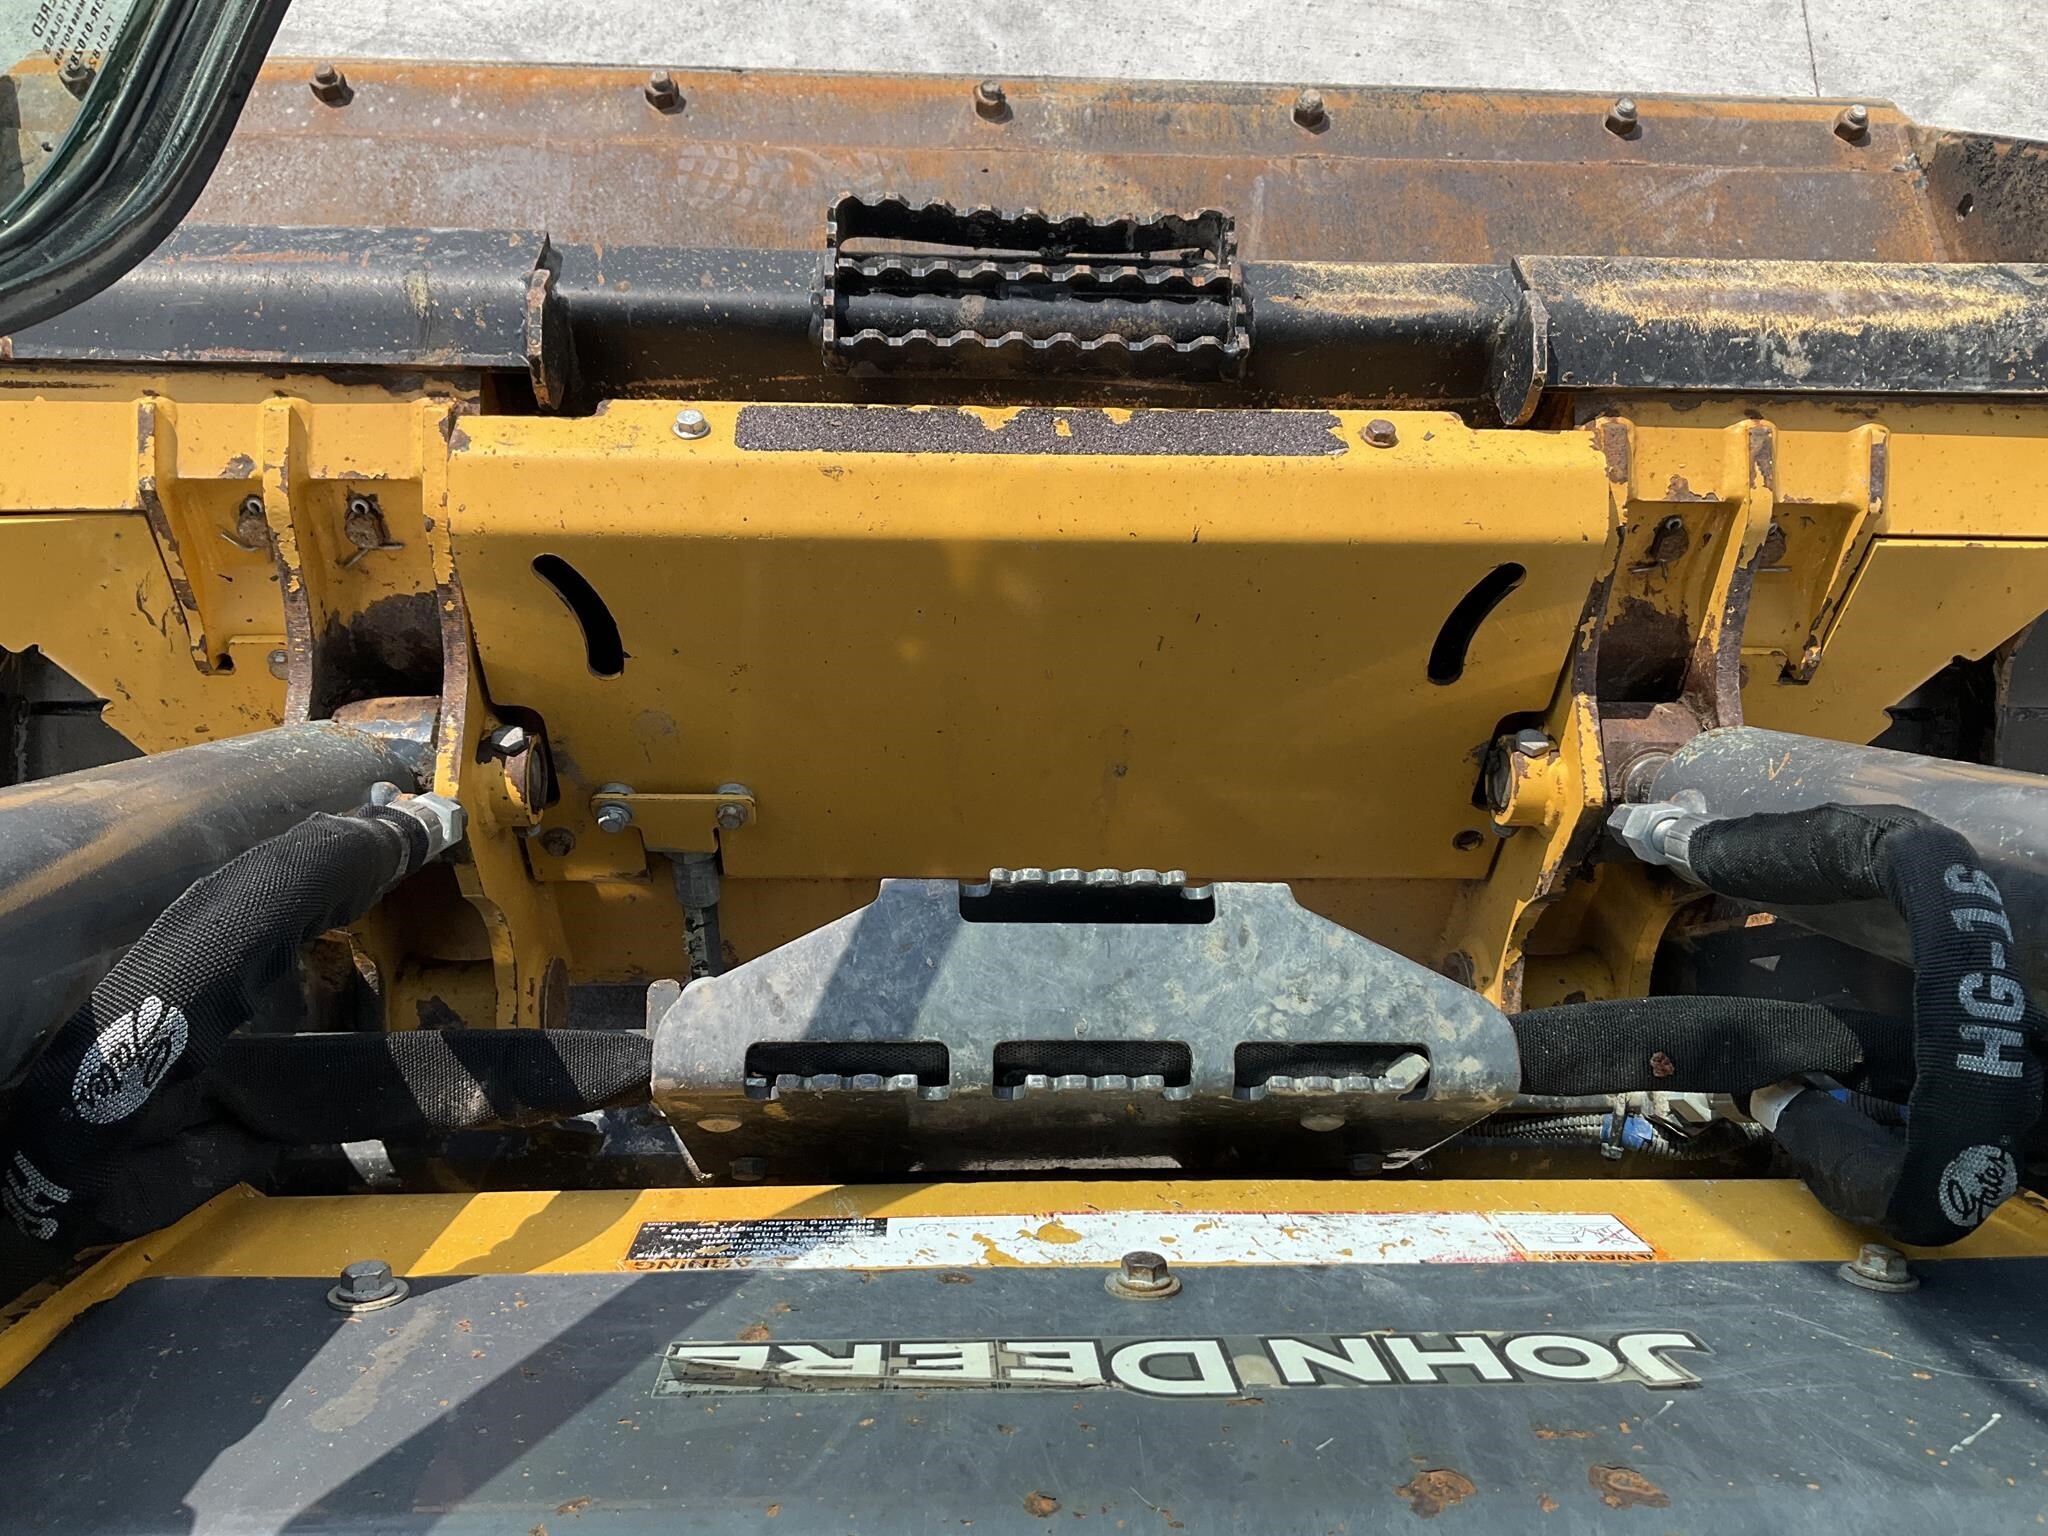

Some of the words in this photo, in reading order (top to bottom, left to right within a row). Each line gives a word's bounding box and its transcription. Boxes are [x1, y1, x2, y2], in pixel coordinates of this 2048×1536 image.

[1944, 863, 2025, 1078] HG-16
[1943, 1144, 2012, 1225] Gates
[634, 1258, 772, 1271] ARNING
[665, 1339, 1239, 1394] DEERE
[1268, 1332, 1700, 1384] JOHN
